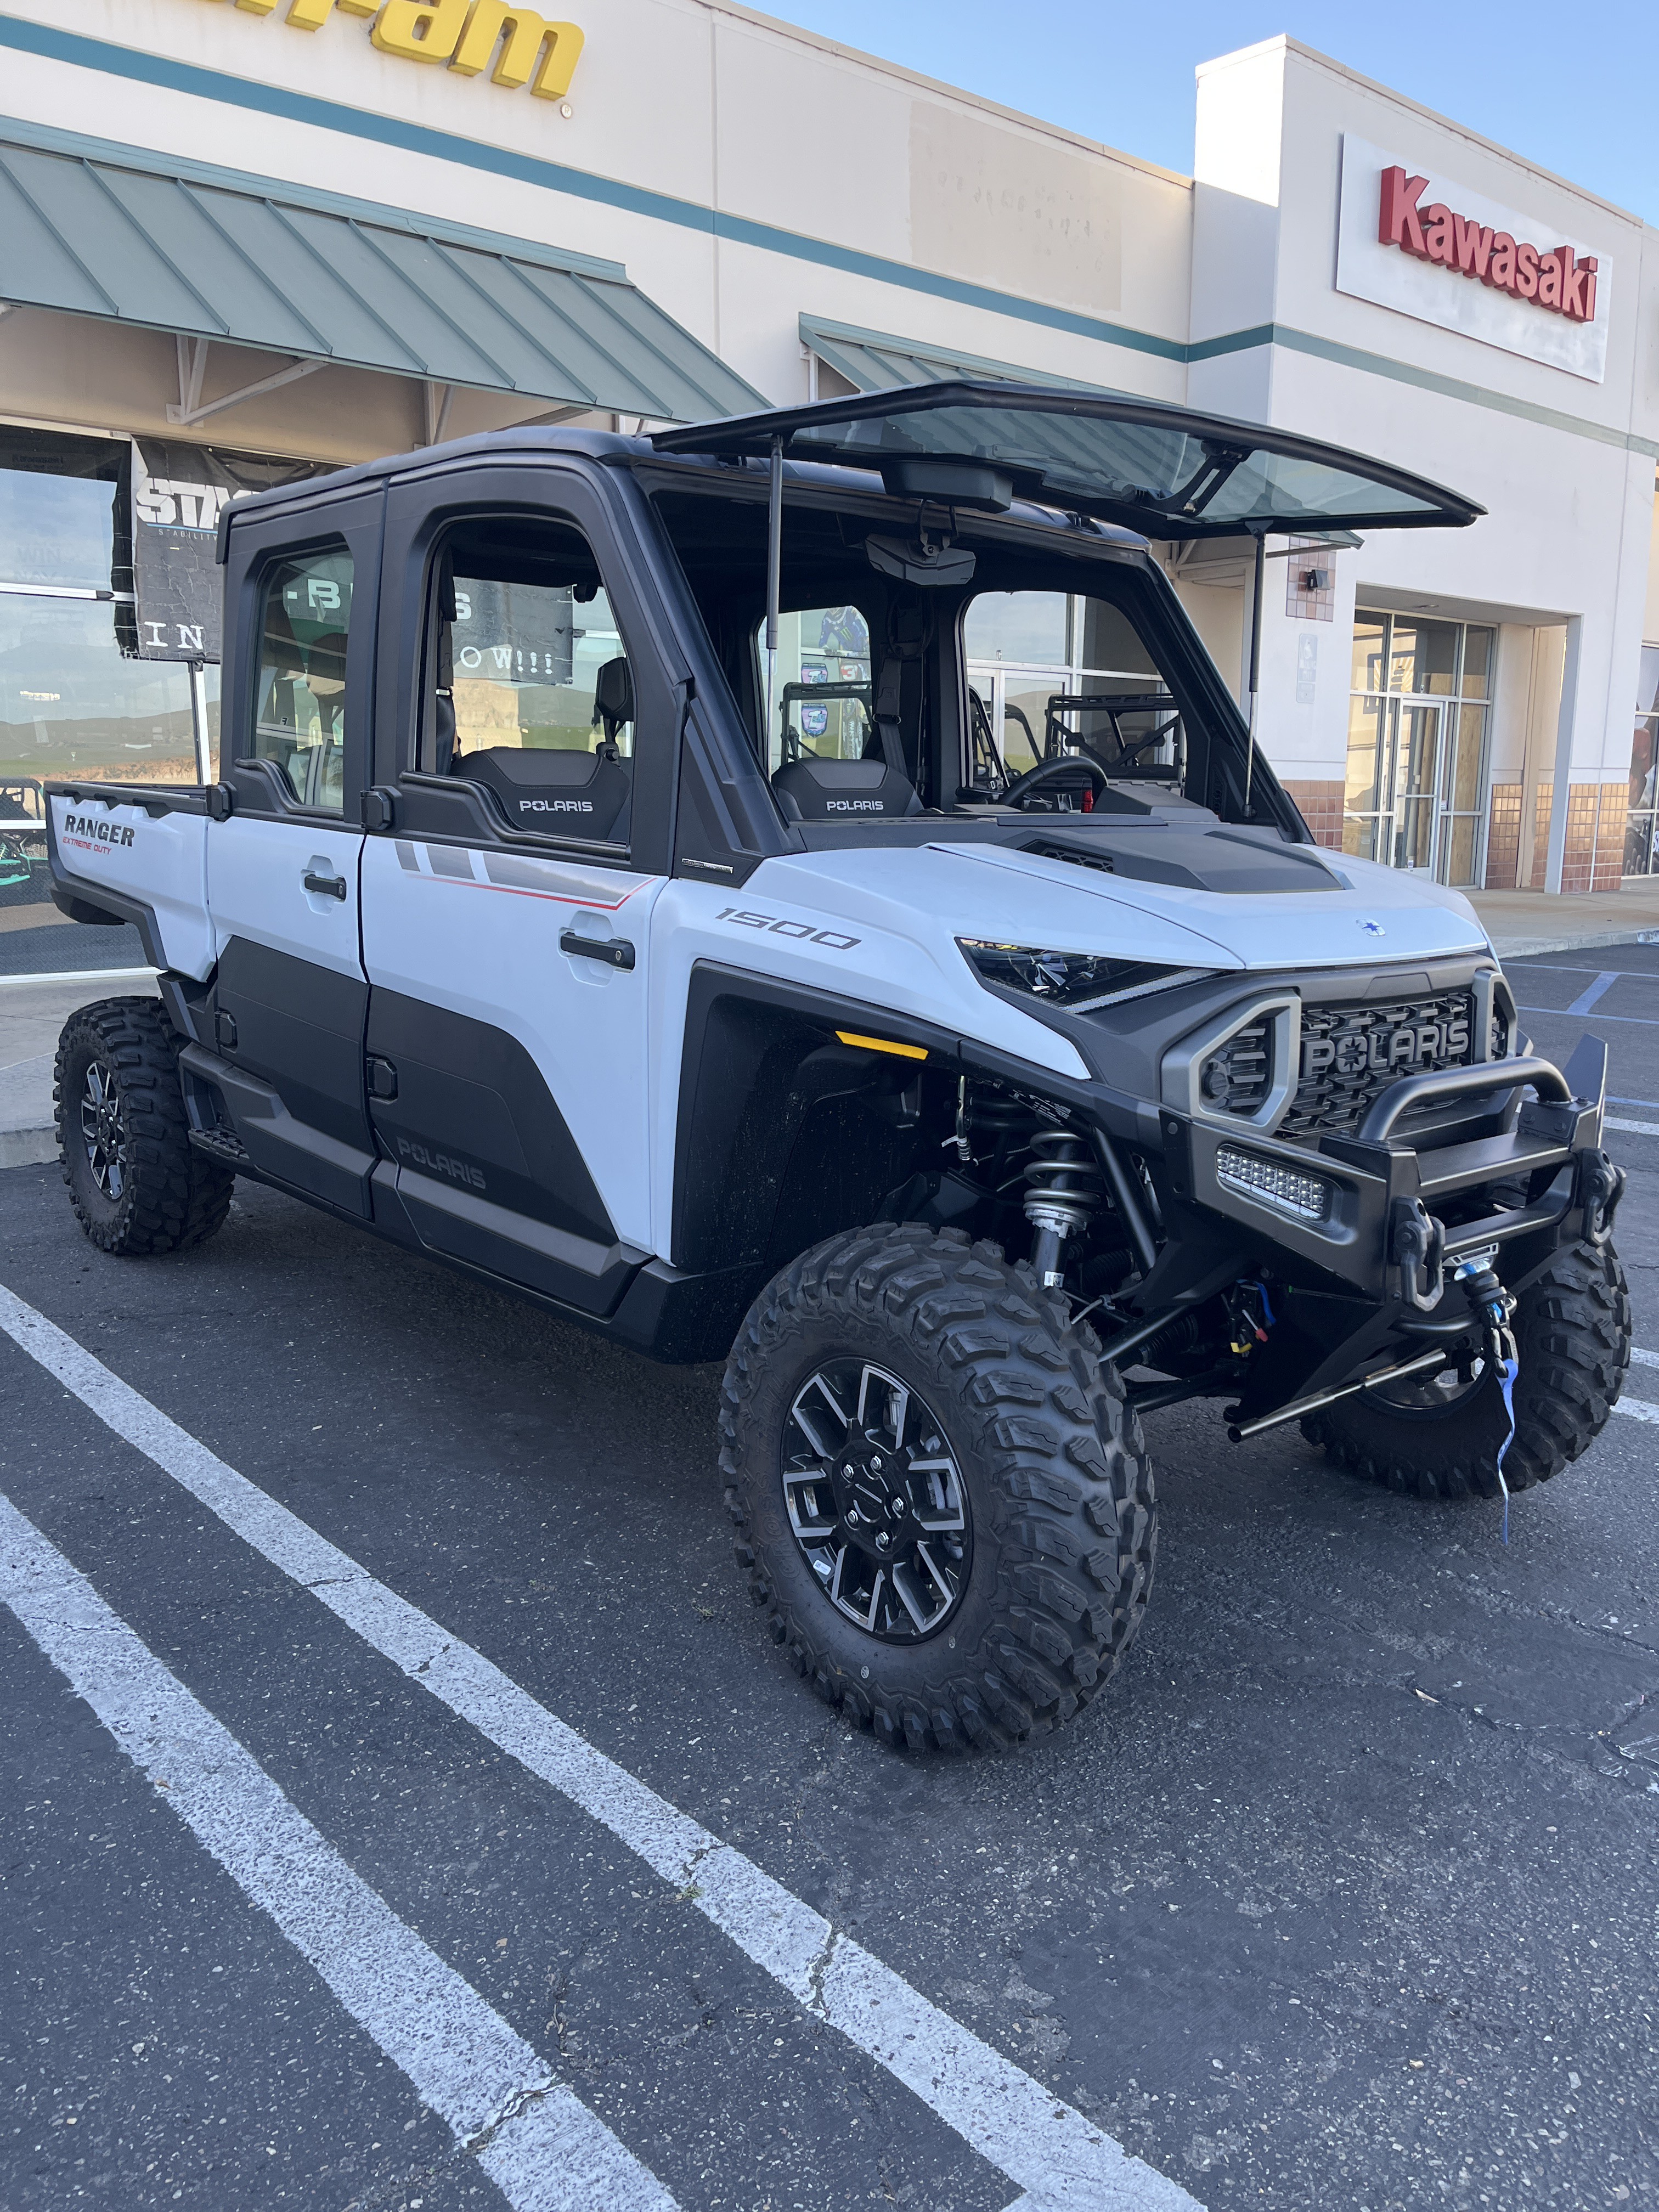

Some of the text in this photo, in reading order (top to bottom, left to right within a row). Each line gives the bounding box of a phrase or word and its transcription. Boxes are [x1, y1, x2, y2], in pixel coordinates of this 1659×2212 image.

[1379, 165, 1598, 323] Kawasaki
[144, 621, 204, 650] IN
[519, 800, 594, 812] POLARIS
[826, 800, 884, 811] POLARIS
[63, 836, 112, 855] EXTREME DUTY
[64, 814, 135, 847] RANGER
[715, 907, 862, 950] 1500
[1304, 1019, 1469, 1077] POLARIS
[397, 1136, 487, 1189] POLARIS
